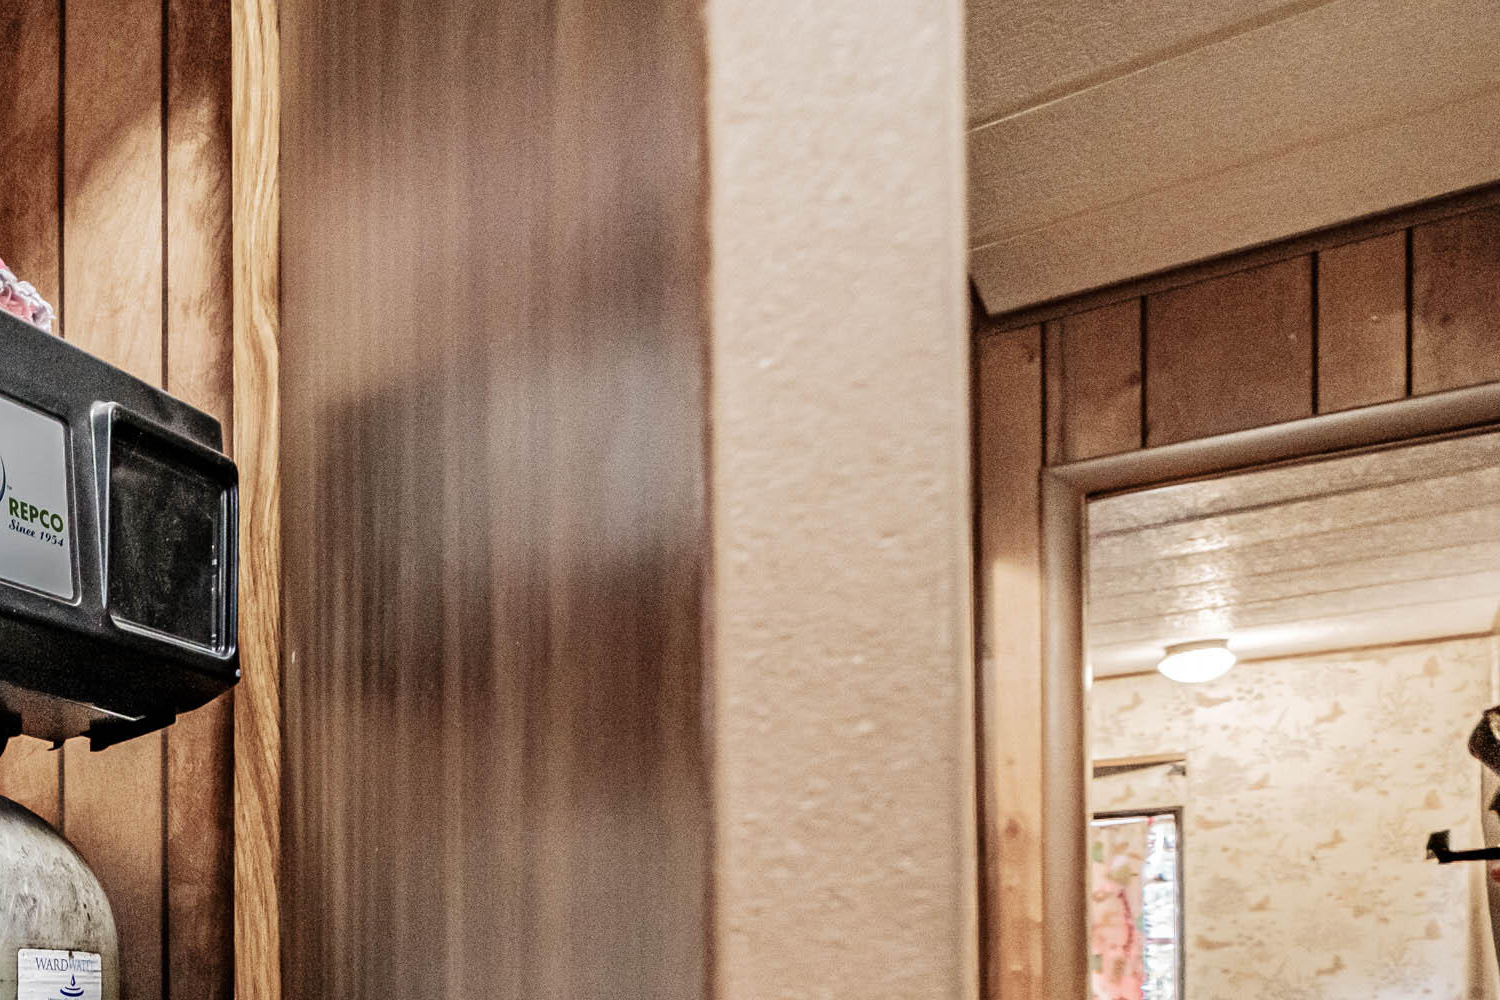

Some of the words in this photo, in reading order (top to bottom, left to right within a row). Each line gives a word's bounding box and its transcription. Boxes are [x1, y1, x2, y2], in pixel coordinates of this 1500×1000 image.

[9, 496, 63, 533] REPCO
[8, 519, 35, 537] Since
[40, 531, 64, 547] 1954
